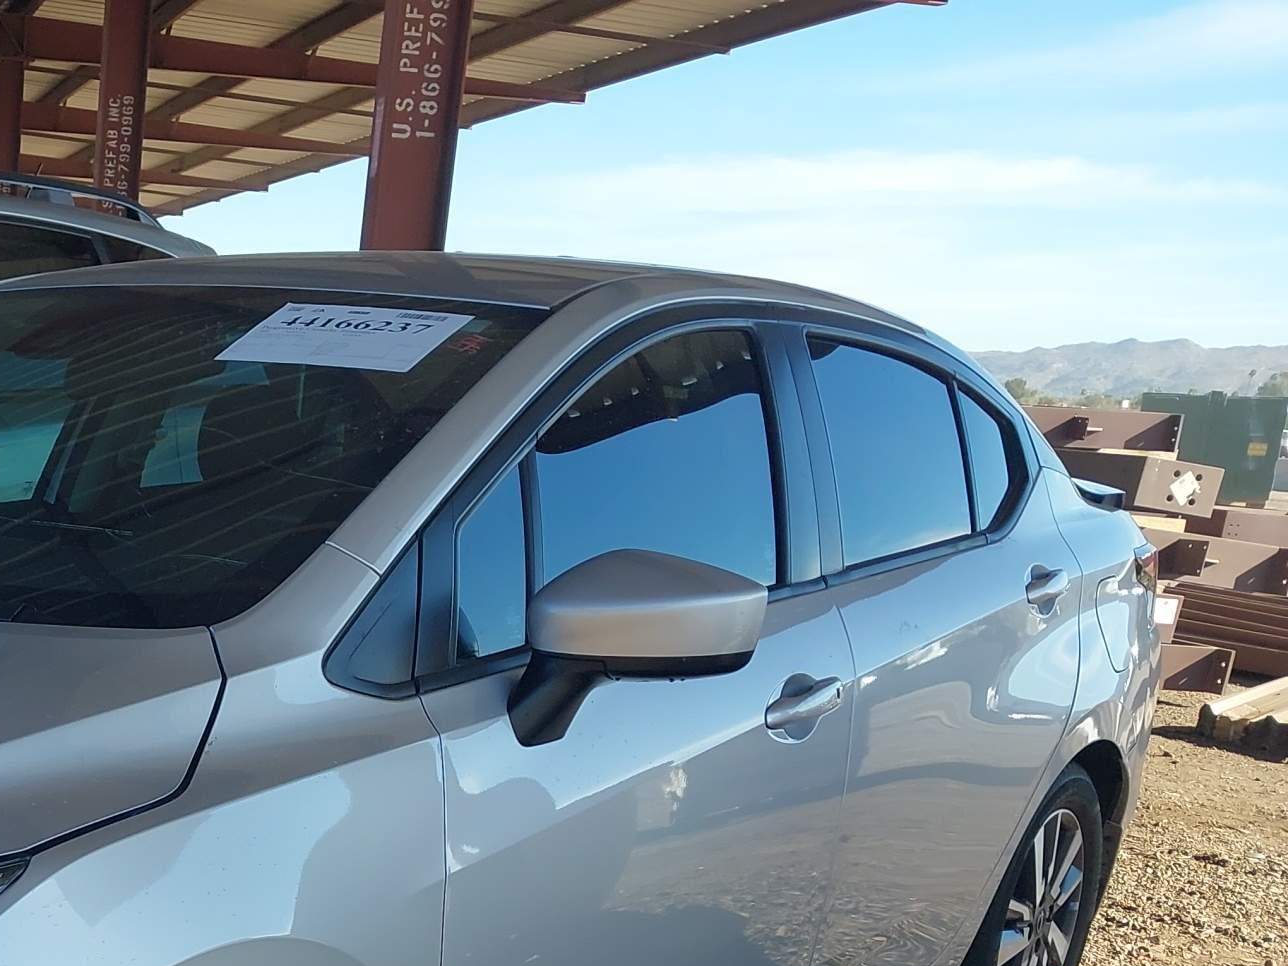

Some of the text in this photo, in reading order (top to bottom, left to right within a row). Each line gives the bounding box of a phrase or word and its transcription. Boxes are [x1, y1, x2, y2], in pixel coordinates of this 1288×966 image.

[392, 2, 424, 139] U.S. PREF
[108, 93, 121, 122] INC.
[103, 129, 118, 188] PREFAB
[280, 315, 436, 335] 44166237
